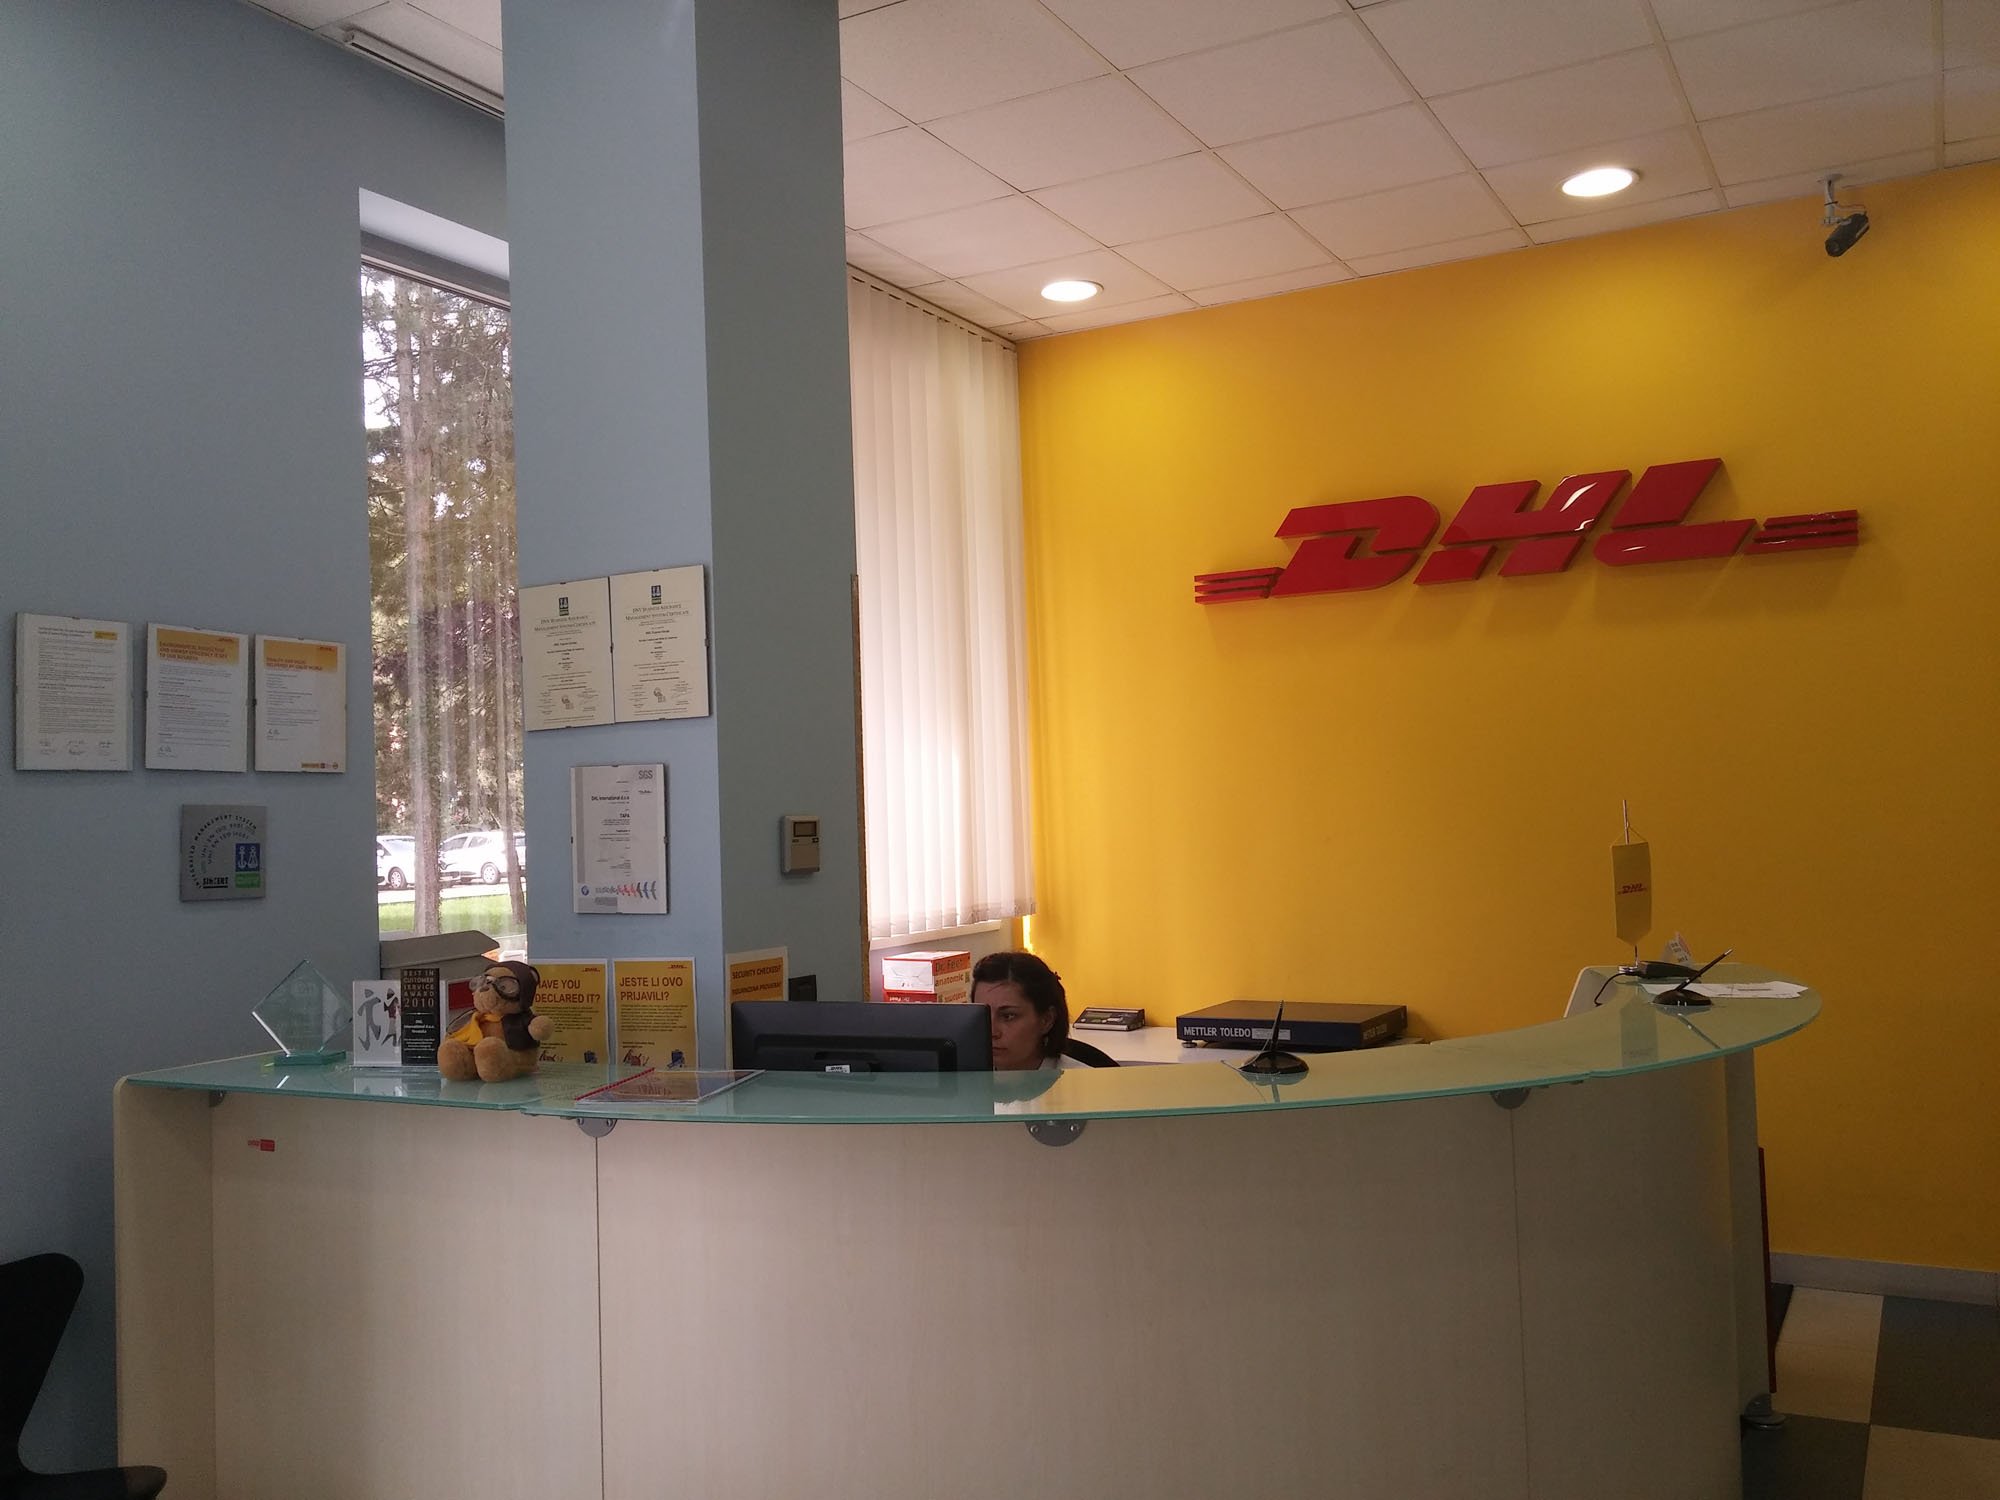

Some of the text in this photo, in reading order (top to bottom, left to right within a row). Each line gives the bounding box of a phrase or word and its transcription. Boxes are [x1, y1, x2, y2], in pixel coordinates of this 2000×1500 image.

[1269, 457, 1758, 598] DHL
[638, 769, 653, 780] SGS
[732, 968, 756, 979] SECURITY
[561, 979, 581, 990] YOU
[620, 976, 683, 987] JESTE LI OVO
[935, 973, 964, 987] anatomic
[535, 993, 601, 1004] DECLARED IT?
[621, 991, 670, 1001] PRIJAVILI?
[404, 998, 434, 1008] 2010
[1183, 1026, 1217, 1037] METTLER
[1220, 1027, 1251, 1038] TOLEDO
